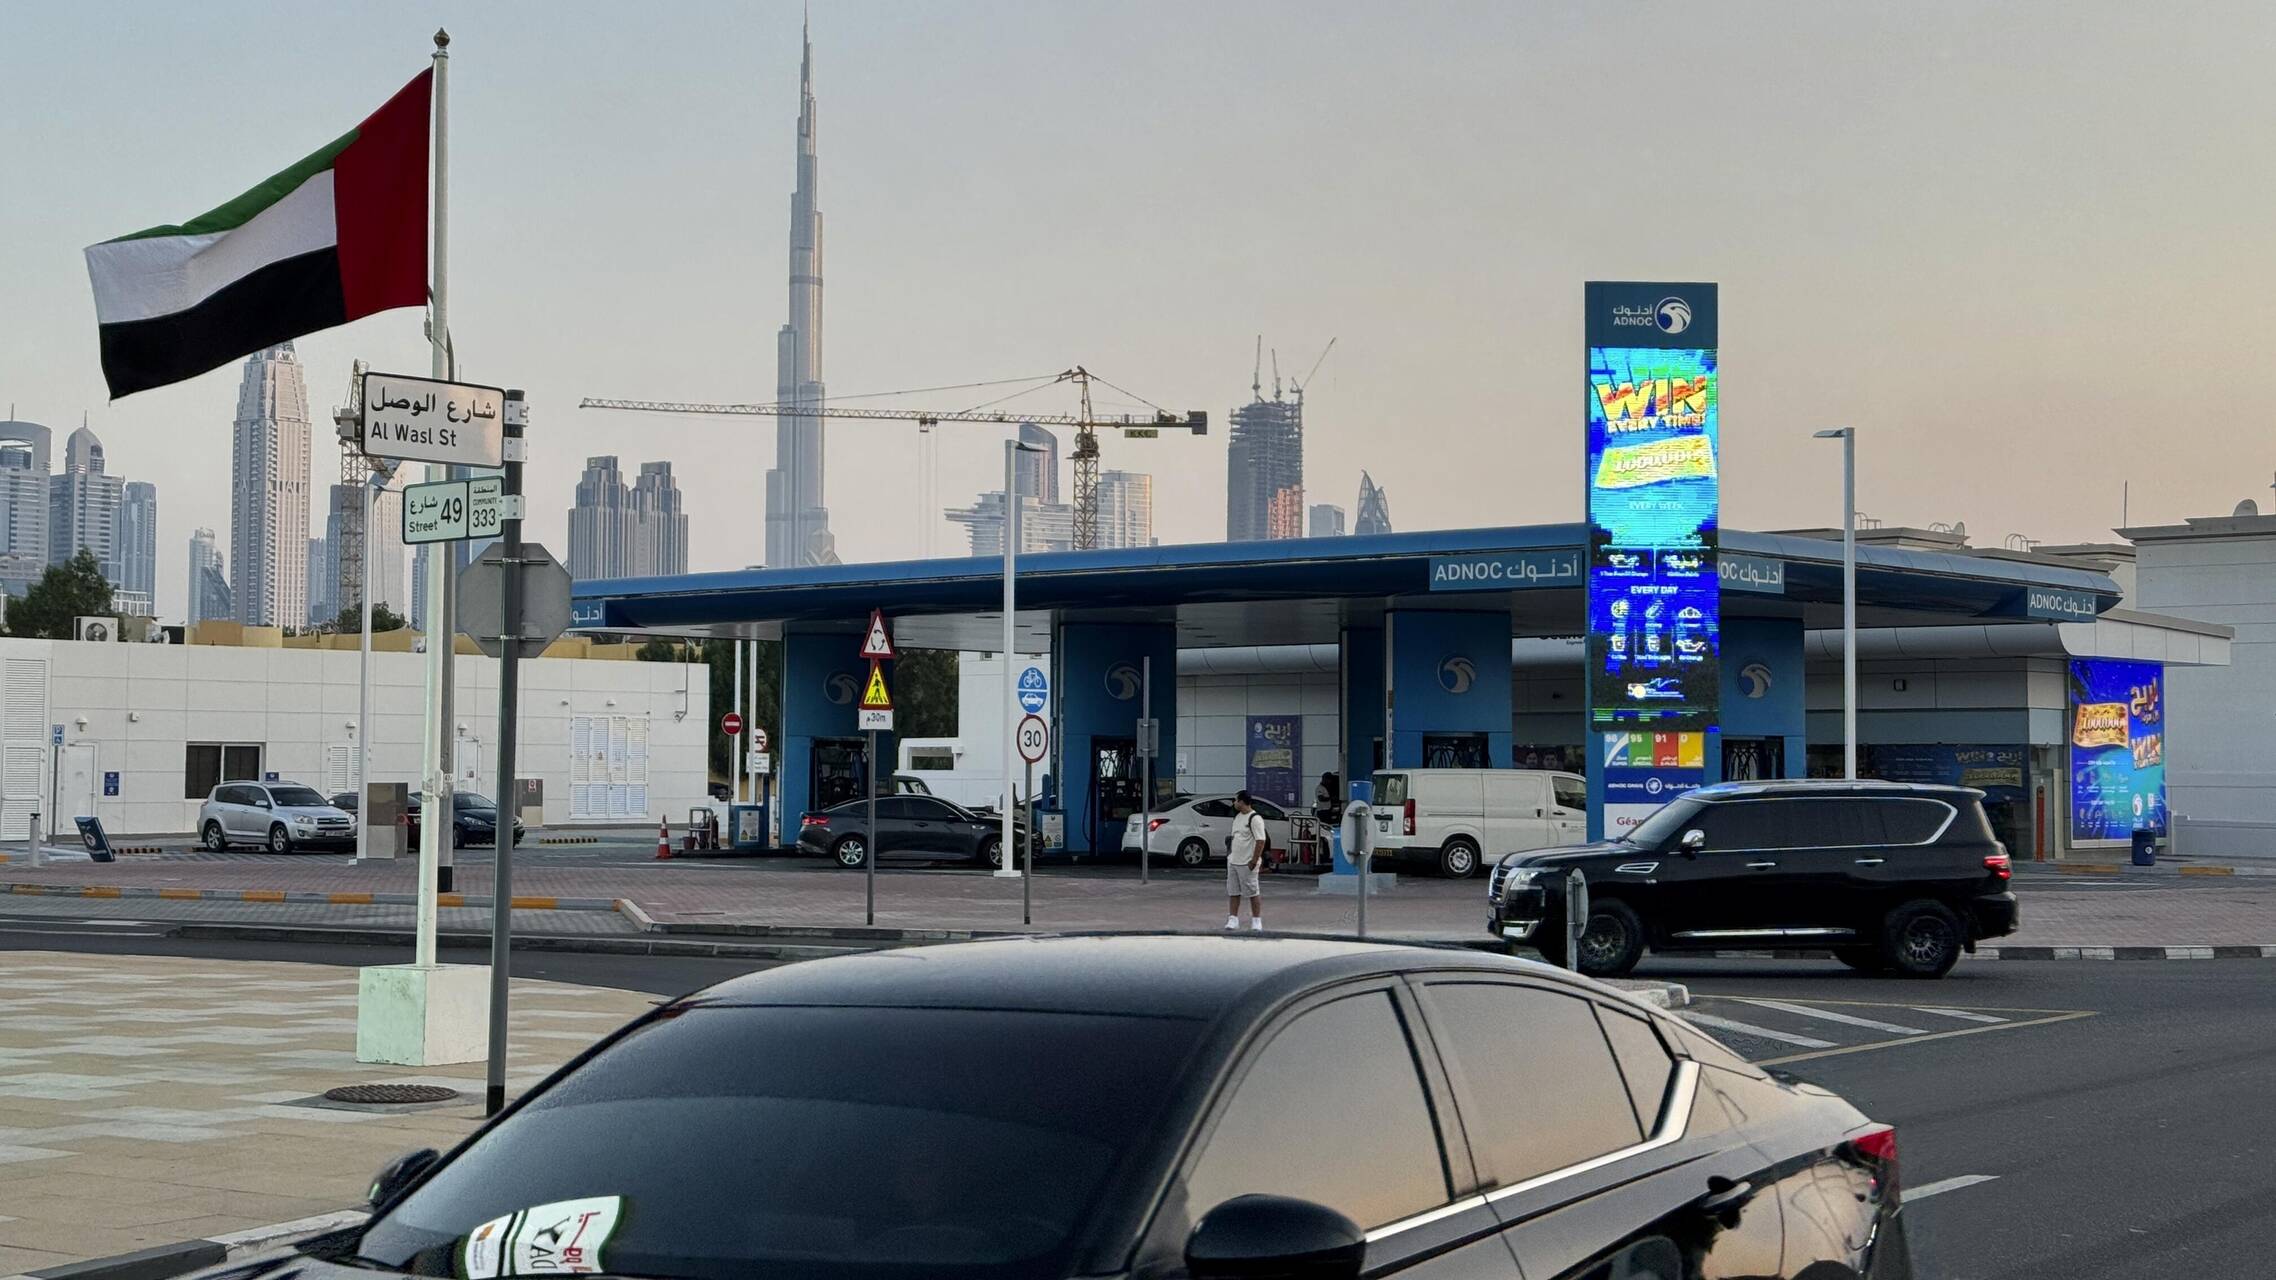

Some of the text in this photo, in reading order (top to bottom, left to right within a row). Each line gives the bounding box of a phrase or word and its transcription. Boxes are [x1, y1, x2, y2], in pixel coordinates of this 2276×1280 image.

[1612, 303, 1653, 316] أدنوك
[1612, 316, 1653, 326] ADNOC
[371, 386, 496, 423] شارع الوصل
[1596, 375, 1707, 421] WIN
[371, 421, 457, 447] Al Wasl St
[410, 495, 438, 515] شارع
[440, 497, 463, 524] 49
[409, 521, 438, 533] Street
[473, 508, 496, 528] 333
[1435, 554, 1578, 582] ADNOC أدنوك
[1740, 563, 1782, 587] أدنوك
[1631, 586, 1679, 594] EVERY DAY
[570, 602, 603, 624] أدنو
[2030, 593, 2095, 617] ADNOC أدنوك
[1024, 730, 1041, 747] 30
[1630, 734, 1642, 742] 95
[1655, 734, 1667, 742] 91
